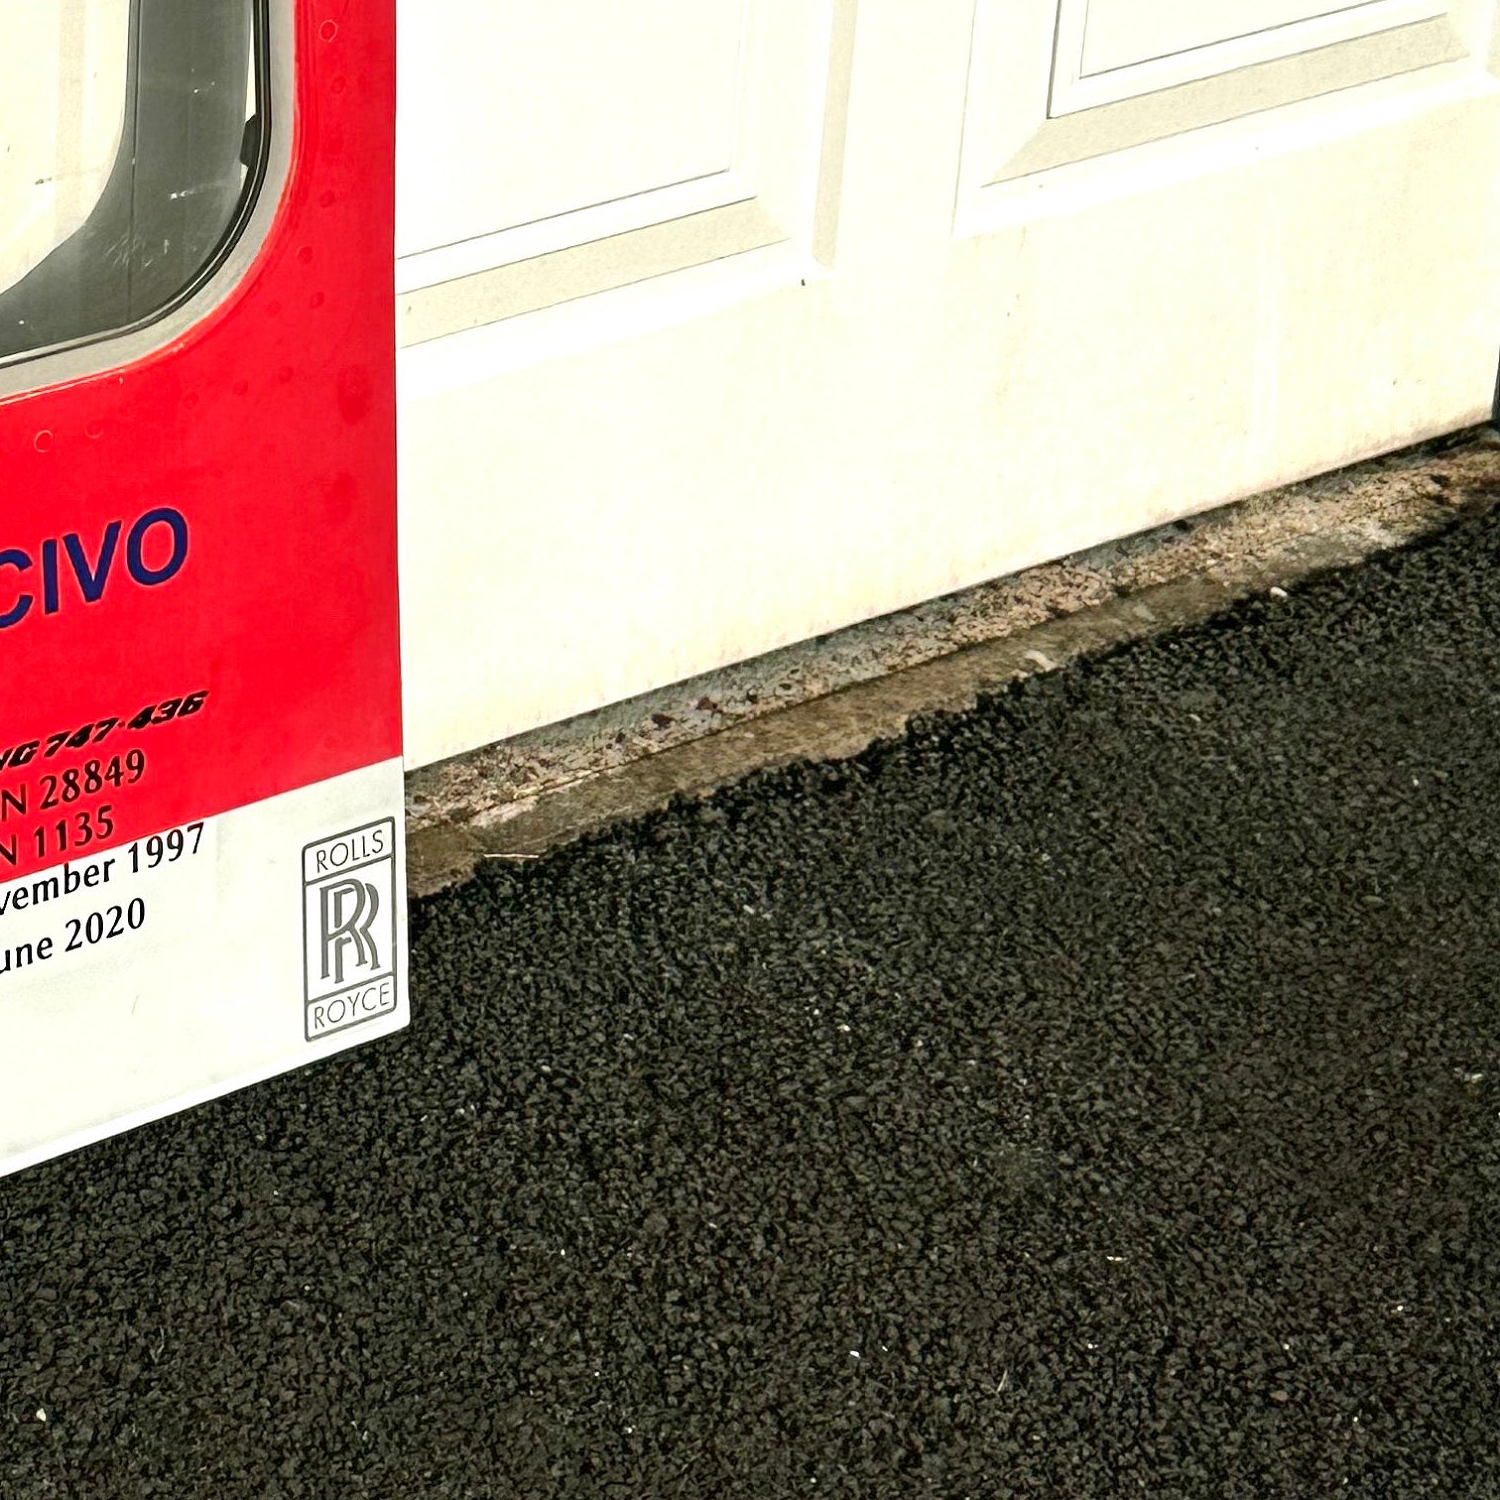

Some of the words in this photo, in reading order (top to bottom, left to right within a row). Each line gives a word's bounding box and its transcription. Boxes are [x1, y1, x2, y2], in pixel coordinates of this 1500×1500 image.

[40, 749, 145, 810] 28849
[33, 805, 114, 858] 1135
[128, 822, 204, 874] 1997
[316, 829, 384, 873] ROLLS
[65, 898, 146, 952] 2020
[314, 982, 390, 1030] ROYCE
